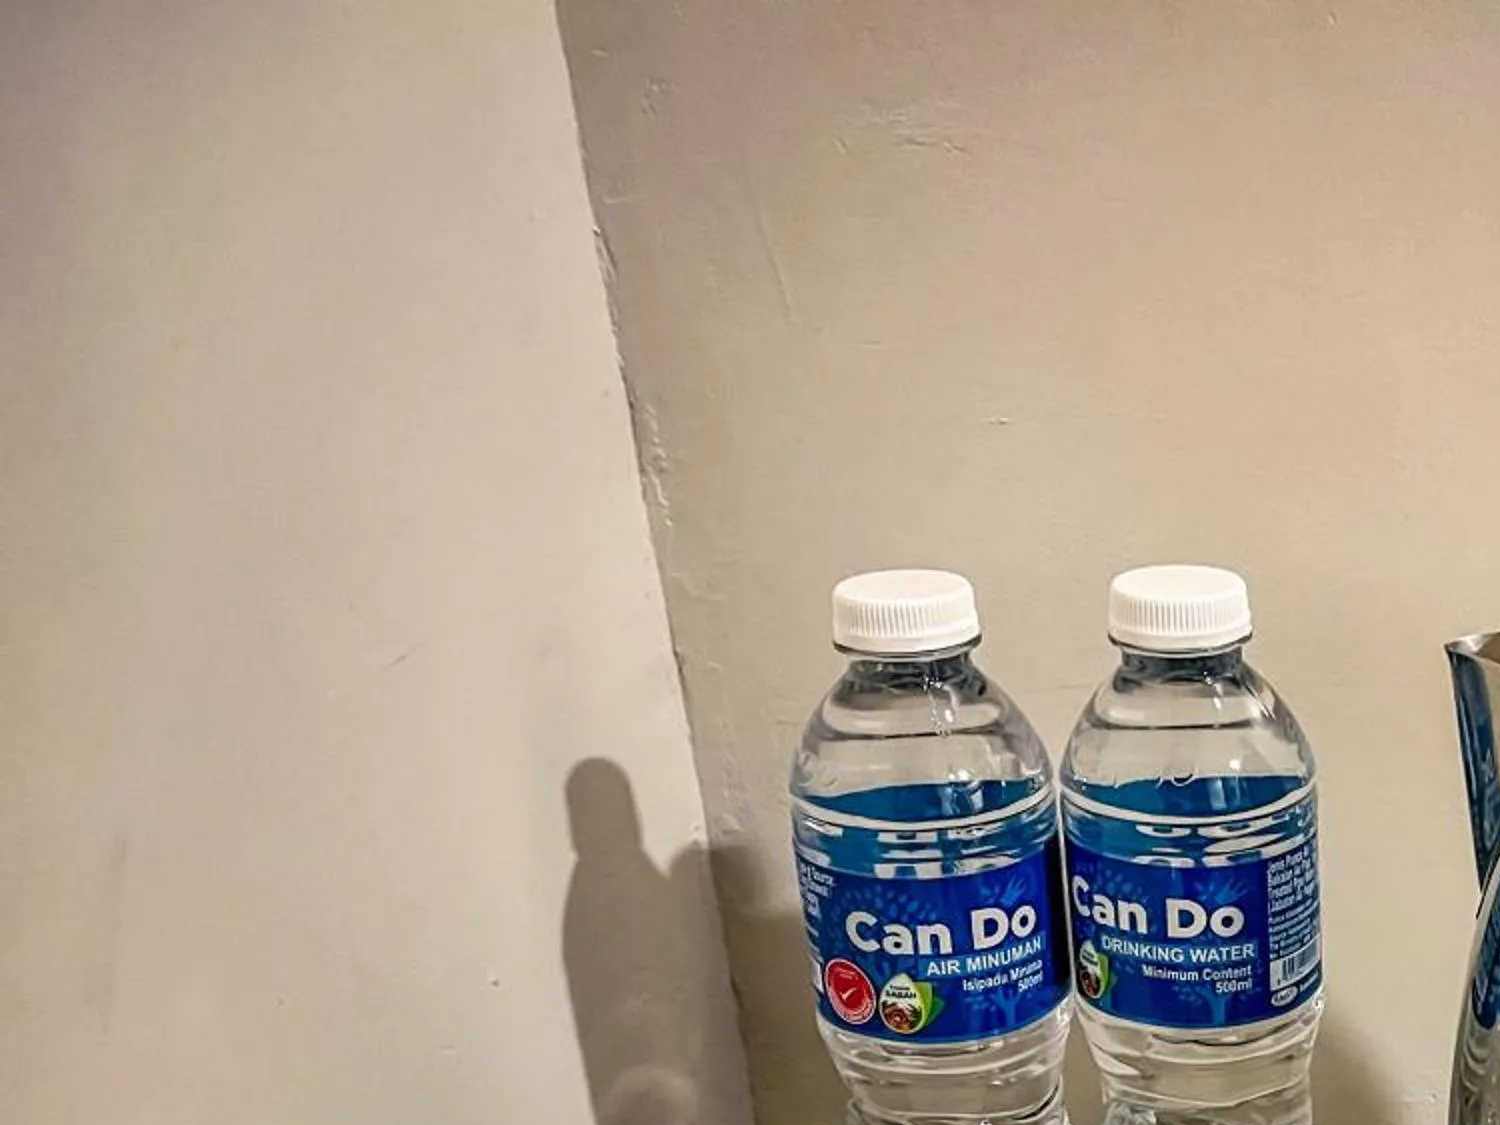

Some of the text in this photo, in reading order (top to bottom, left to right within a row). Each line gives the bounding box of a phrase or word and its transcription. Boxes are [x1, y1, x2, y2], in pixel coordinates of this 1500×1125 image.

[1072, 875, 1148, 935] Can
[1165, 898, 1245, 939] Do
[845, 905, 1037, 956] Can Do
[926, 938, 1042, 977] AIR MINUMAN
[1102, 935, 1255, 963] DRINKING WATER
[1142, 963, 1252, 981] Minimum Content
[1215, 979, 1252, 994] 500ml
